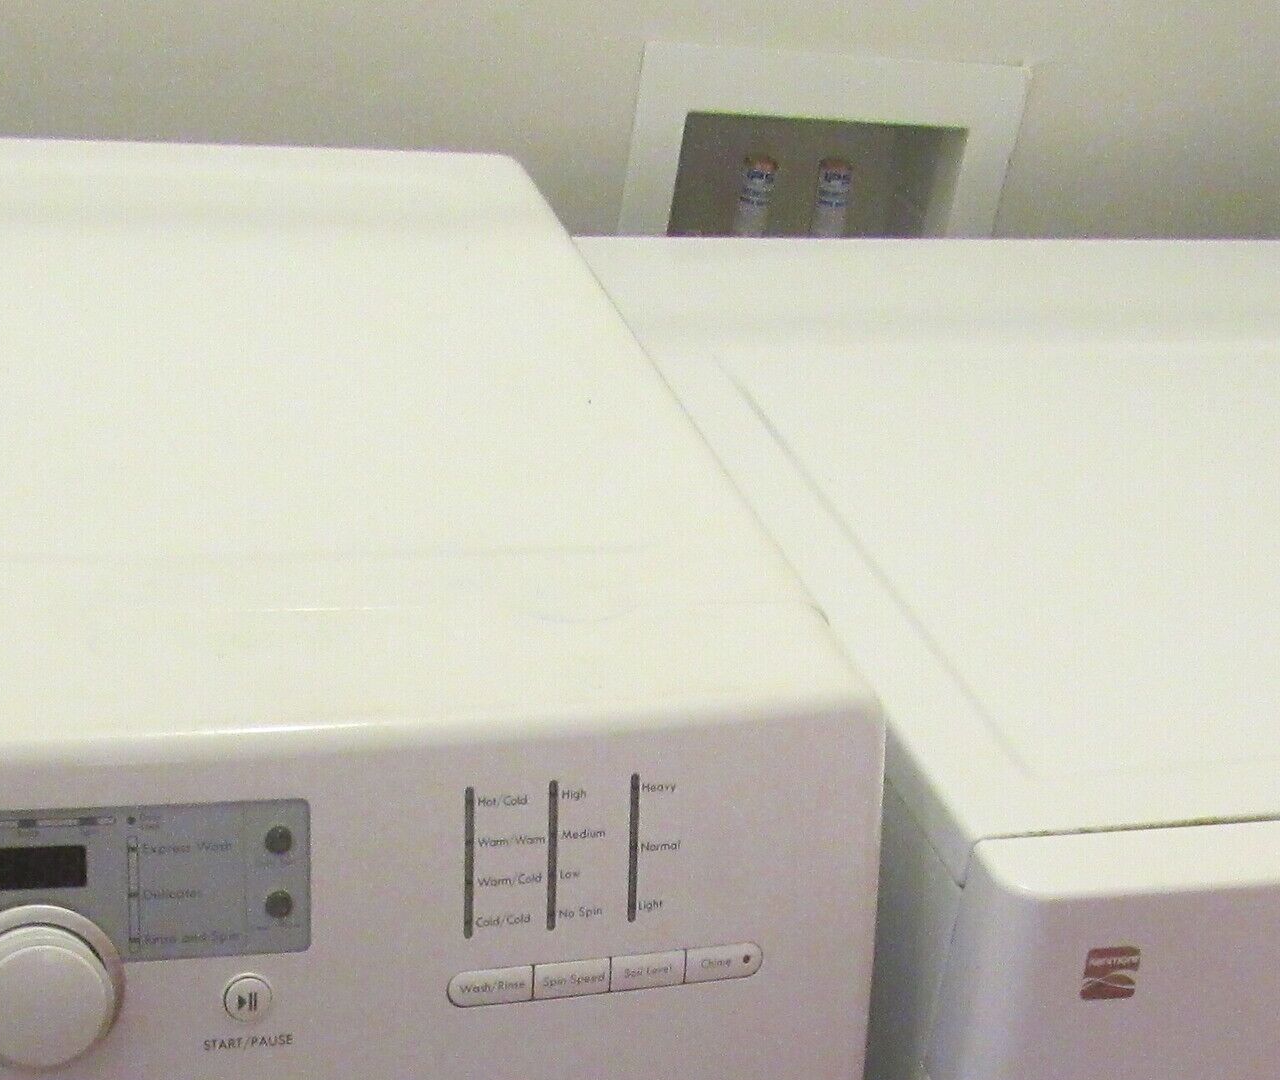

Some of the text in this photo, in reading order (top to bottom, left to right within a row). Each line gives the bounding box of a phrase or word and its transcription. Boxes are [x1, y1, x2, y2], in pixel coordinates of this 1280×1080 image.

[642, 783, 676, 793] Heavy
[561, 789, 587, 800] High
[477, 795, 528, 807] Hot/Cold
[561, 829, 606, 839] Medium
[477, 835, 546, 847] Warm/Warm
[641, 841, 681, 852] Normal
[477, 873, 543, 887] Warm/Cold
[560, 869, 580, 880] Low
[638, 900, 663, 911] Light
[559, 906, 603, 919] No Spin
[475, 914, 531, 928] Cold/Cold
[203, 1034, 294, 1051] START/PAUSE
